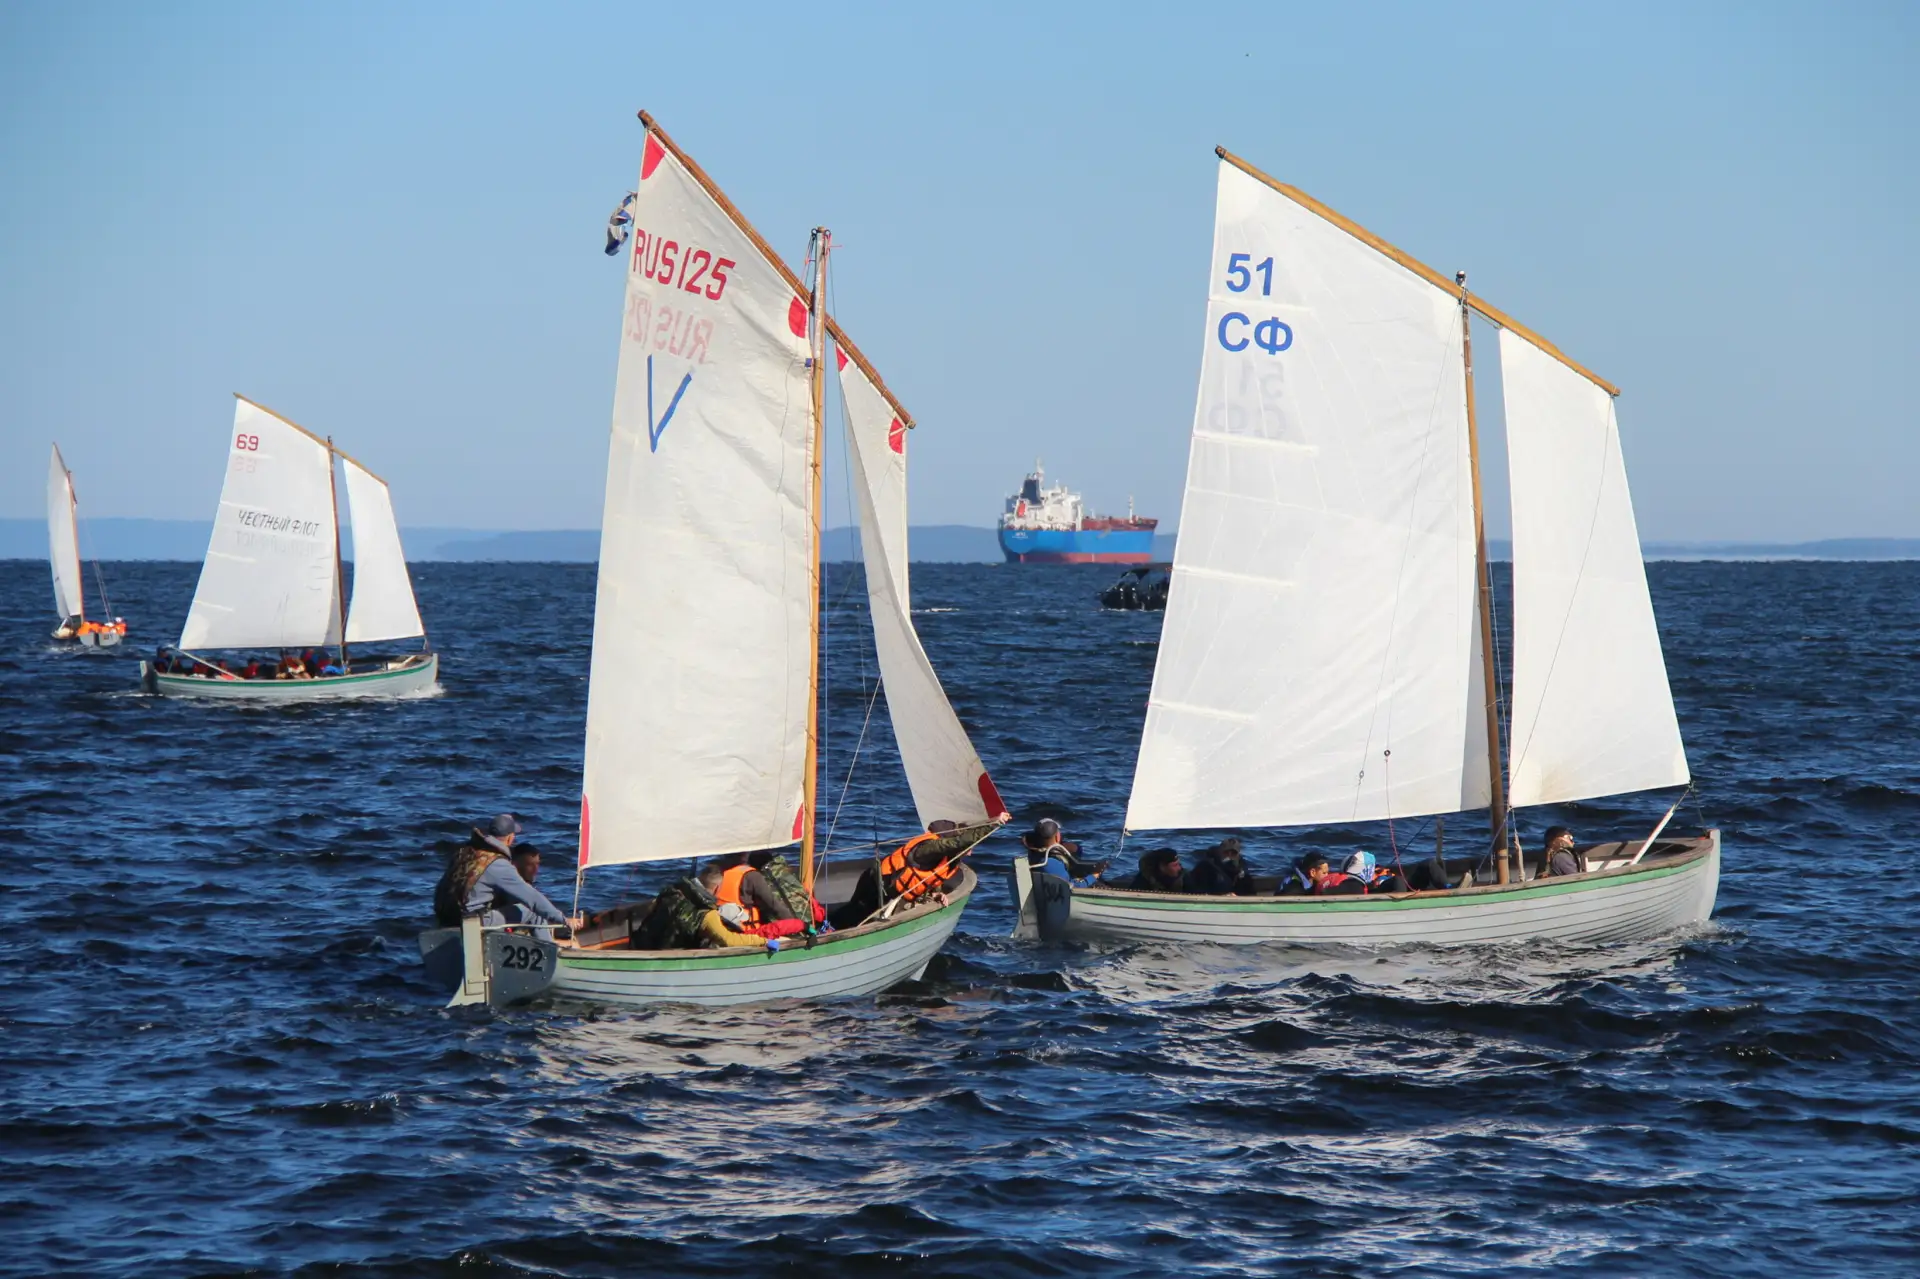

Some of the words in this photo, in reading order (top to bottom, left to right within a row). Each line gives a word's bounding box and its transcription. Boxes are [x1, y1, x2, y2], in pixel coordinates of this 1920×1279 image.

[1226, 252, 1274, 296] 51
[1217, 311, 1293, 355] СФ
[235, 433, 259, 451] 69
[238, 509, 290, 533] ЧЕСТНЫЙ
[291, 519, 320, 537] ФЛОТ
[501, 944, 543, 972] 292
